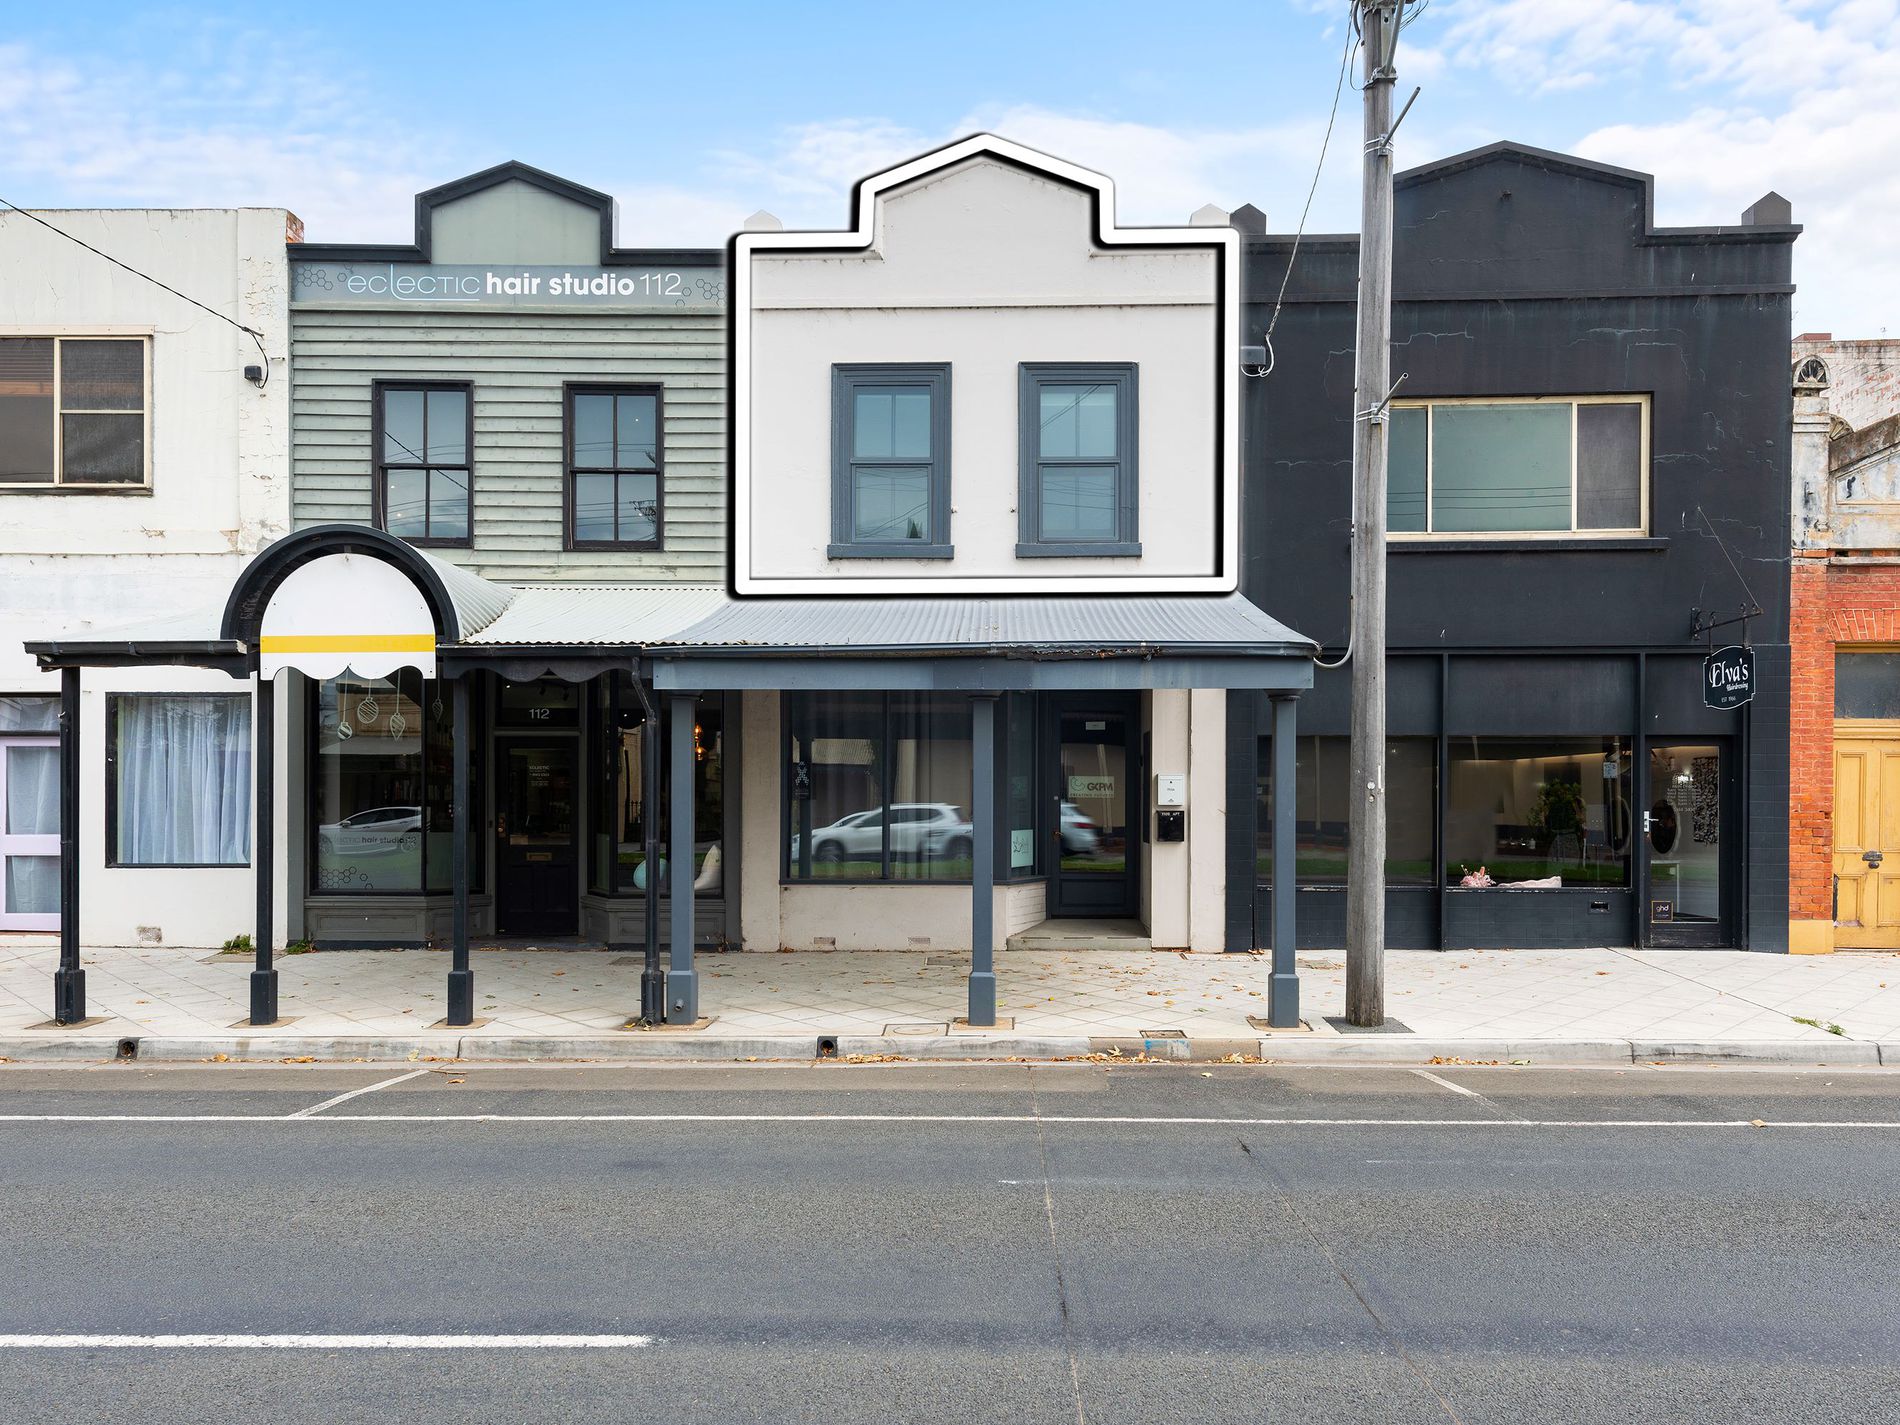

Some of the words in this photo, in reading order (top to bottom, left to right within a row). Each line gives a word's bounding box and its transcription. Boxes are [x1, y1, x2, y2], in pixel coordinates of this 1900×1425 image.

[486, 272, 541, 295] hair
[549, 273, 635, 296] studio
[640, 273, 682, 296] 112
[1709, 658, 1749, 688] Elva's
[528, 708, 550, 719] 112
[361, 836, 378, 844] hair
[380, 836, 404, 844] studio
